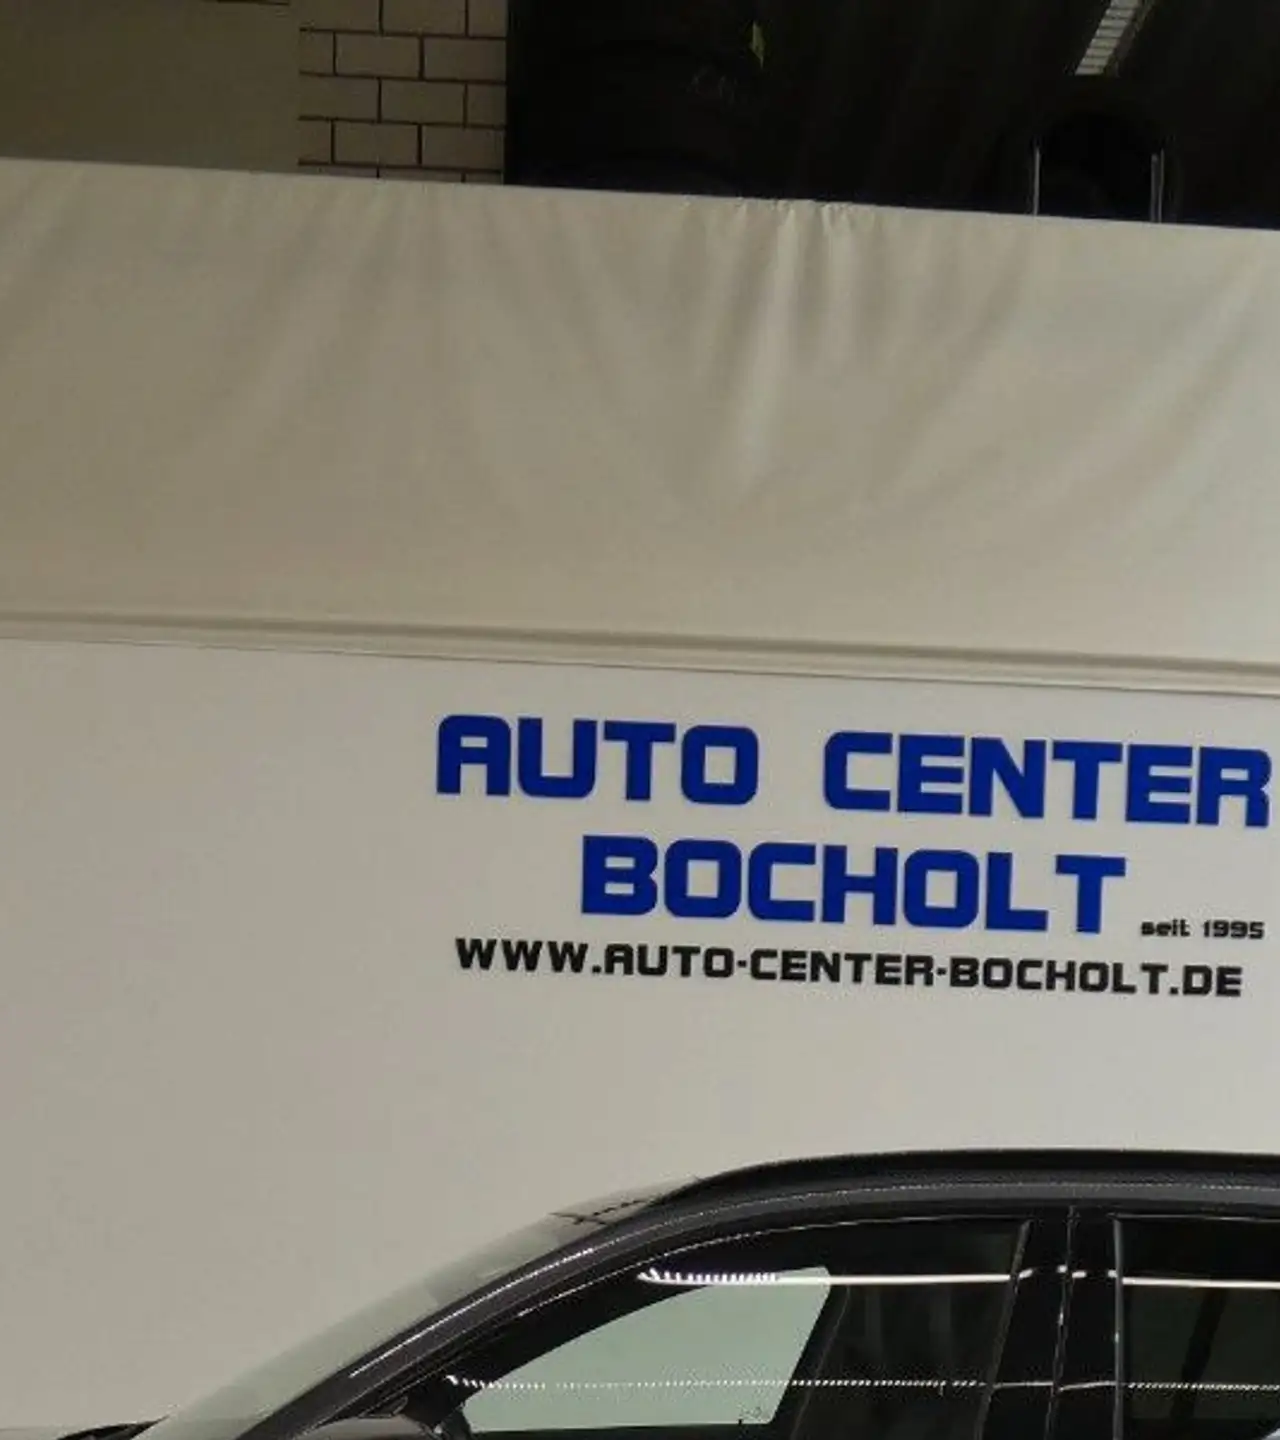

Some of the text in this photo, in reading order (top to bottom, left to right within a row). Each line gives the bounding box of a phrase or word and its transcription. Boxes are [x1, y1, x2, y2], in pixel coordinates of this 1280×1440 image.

[436, 714, 1273, 828] AUTO CENTER
[581, 834, 1128, 936] BOCHOLT
[455, 936, 1243, 998] WWW.AUTO-CENTER-BOCHOLT.DE
[1140, 919, 1265, 941] seit 1995
